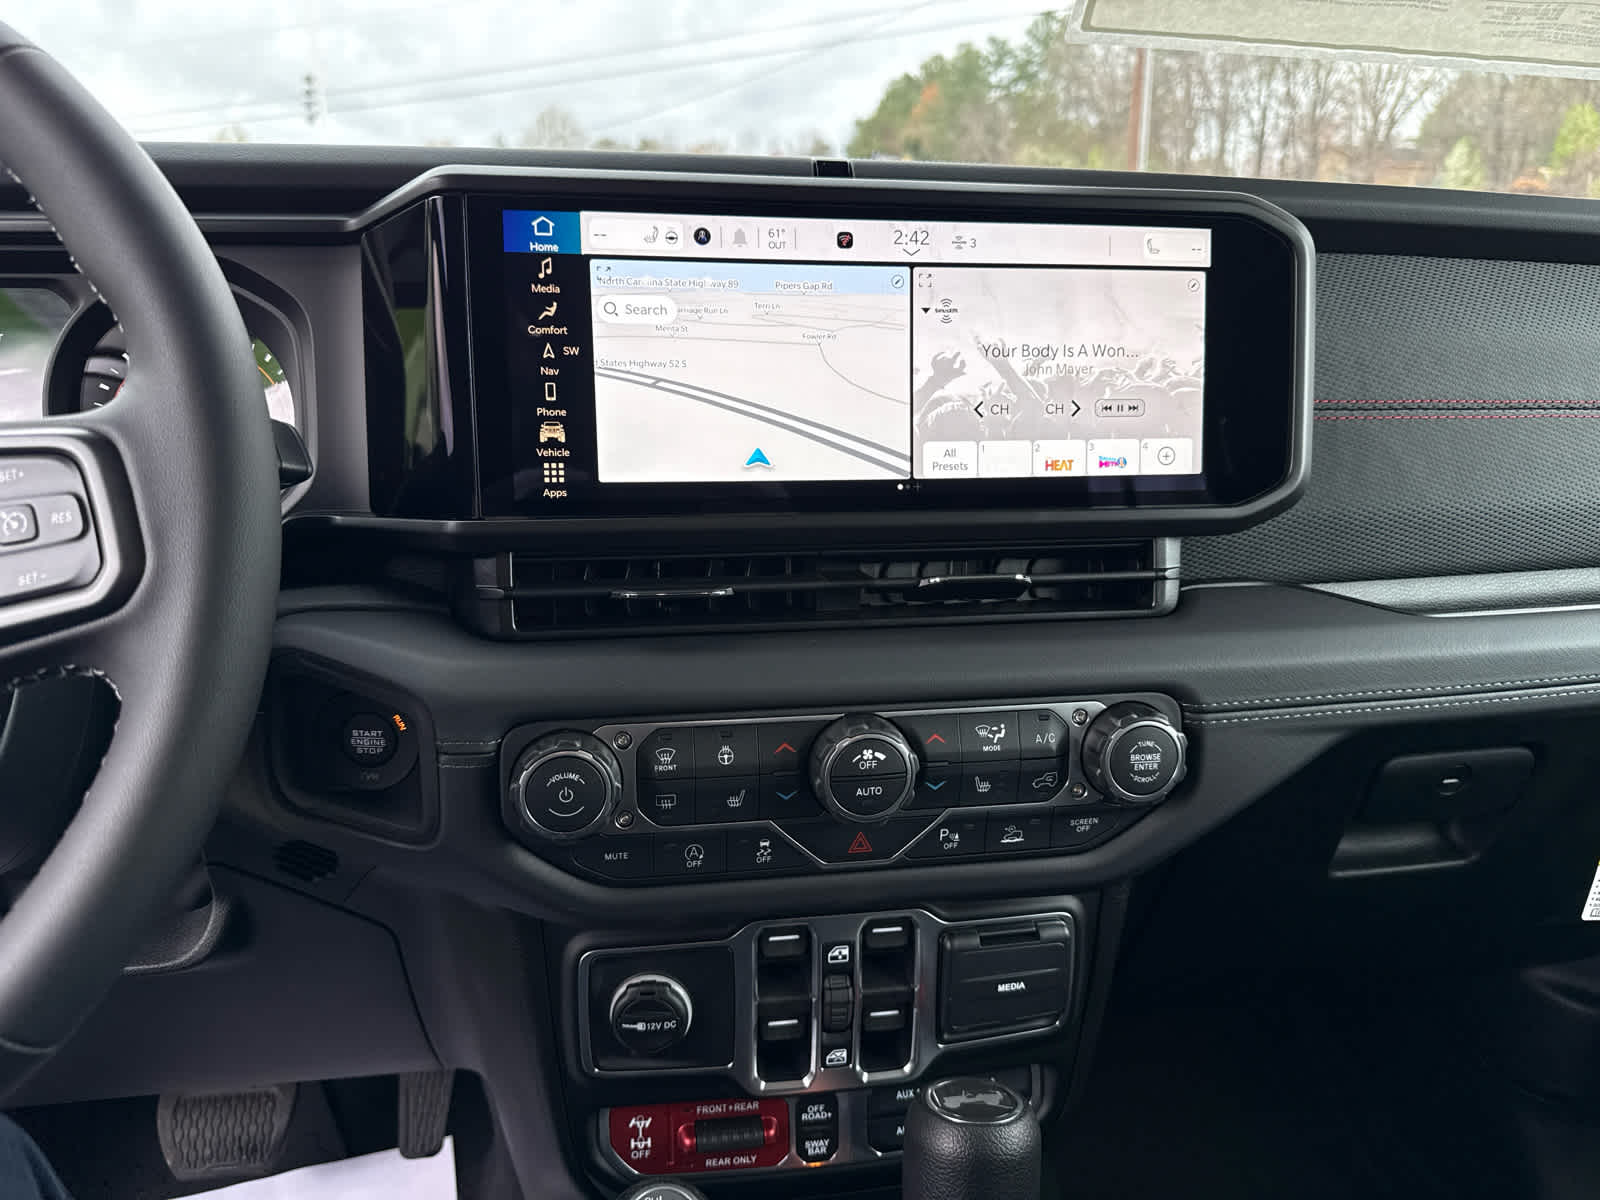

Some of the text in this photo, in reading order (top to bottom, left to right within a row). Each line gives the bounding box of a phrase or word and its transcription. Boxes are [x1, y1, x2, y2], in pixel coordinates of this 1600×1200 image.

[893, 229, 930, 246] 2:42
[529, 242, 559, 252] Home
[768, 241, 786, 250] OUT
[969, 238, 977, 249] 3
[664, 278, 687, 288] State
[727, 280, 739, 288] 89
[775, 281, 833, 292] Pipers Gap Rd
[531, 283, 561, 294] Media
[624, 303, 668, 316] Search
[527, 324, 568, 335] Comfort
[562, 346, 580, 356] SW
[982, 344, 1017, 358] Your
[1021, 344, 1058, 360] Body
[1063, 345, 1074, 358] Is
[1077, 345, 1089, 357] A
[600, 359, 626, 367] States
[629, 360, 667, 369] Highway
[669, 359, 680, 368] 52
[681, 359, 688, 368] S
[540, 366, 560, 376] Nav
[1025, 364, 1093, 377] John Mayer
[536, 407, 567, 417] Phone
[990, 404, 1010, 415] CH
[1045, 404, 1065, 415] CH
[536, 448, 570, 457] Vehicle
[943, 448, 957, 458] All
[932, 461, 969, 471] Presets
[1045, 459, 1074, 471] HEAT
[543, 488, 568, 499] Apps
[51, 511, 73, 525] RES
[392, 714, 407, 731] RUN
[1035, 732, 1056, 745] A/C
[1130, 753, 1161, 761] BROWSE
[654, 764, 677, 772] FRONT
[859, 761, 878, 770] OFF
[1134, 763, 1159, 771] ENTER
[550, 772, 581, 782] VOLUME
[856, 786, 883, 797] AUTO
[1070, 817, 1099, 827] SCREEN
[1075, 825, 1091, 833] OFF
[943, 842, 958, 850] OFF
[604, 851, 629, 861] MUTE
[755, 855, 772, 864] OFF
[686, 859, 703, 868] OFF
[997, 981, 1026, 993] MEDIA
[646, 1020, 677, 1030] 12V DC
[807, 1104, 825, 1113] OFF
[804, 1139, 830, 1149] SWAY
[630, 1150, 651, 1160] OFF
[807, 1147, 828, 1156] BAR
[705, 1155, 757, 1168] REAR ONLY
